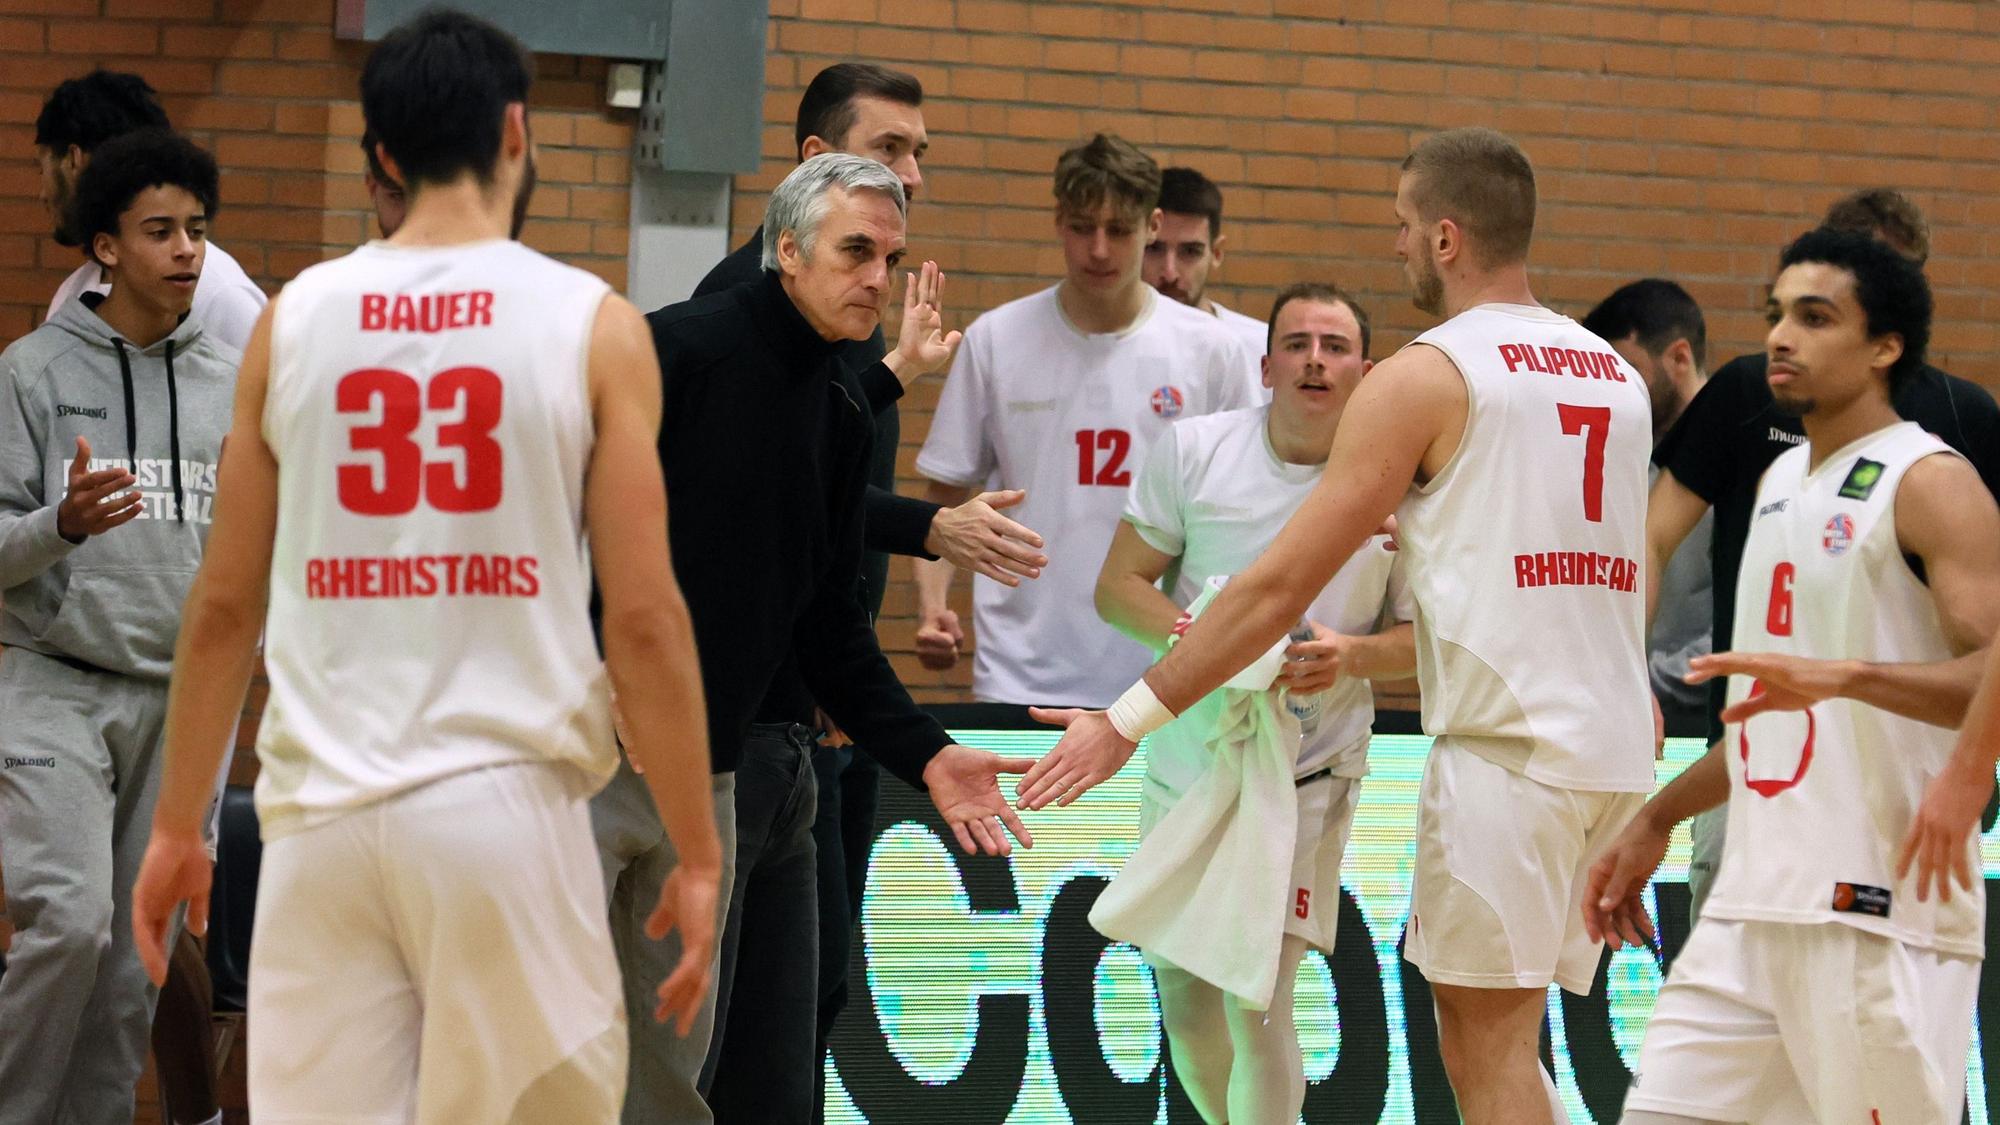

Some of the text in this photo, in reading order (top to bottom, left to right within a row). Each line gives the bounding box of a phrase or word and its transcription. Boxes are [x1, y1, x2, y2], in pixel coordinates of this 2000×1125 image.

[361, 290, 494, 333] BAUER
[1497, 343, 1628, 383] PILIPOVIC
[56, 404, 107, 420] SPALDING
[336, 367, 504, 517] 33
[1075, 428, 1131, 487] 12
[1556, 402, 1611, 523] 7
[306, 555, 539, 599] RHEINSTARS
[1766, 561, 1795, 637] 6
[4, 756, 56, 769] SPALDING
[1296, 887, 1310, 919] 5
